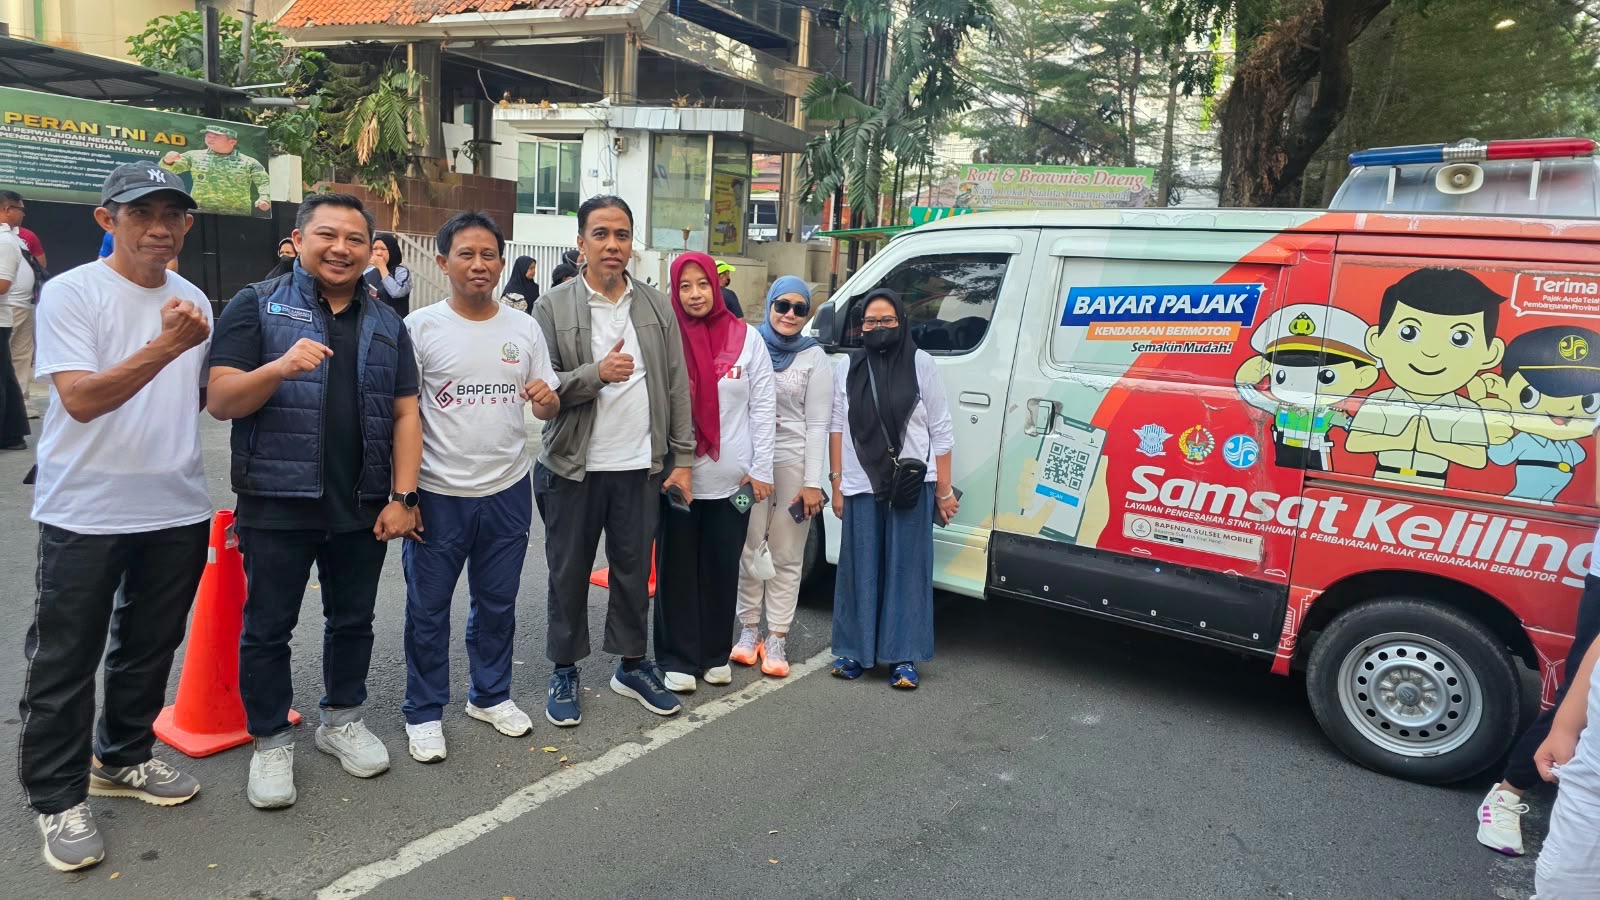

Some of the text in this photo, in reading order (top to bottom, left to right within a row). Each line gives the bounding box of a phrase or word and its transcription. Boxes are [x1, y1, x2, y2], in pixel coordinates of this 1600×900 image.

[4, 111, 187, 147] PERAN TNI AD
[13, 127, 85, 142] PERWUJUDAN
[87, 136, 128, 146] NEGARA
[0, 131, 60, 145] MENGATASI
[62, 139, 122, 152] KEBUTUHAN
[124, 146, 161, 156] RAKYAT
[967, 167, 1146, 192] Roti & Brownies Daeng
[1533, 276, 1598, 295] Terima
[1072, 293, 1249, 315] BAYAR PAJAK
[1523, 301, 1571, 310] Pembangunan
[1543, 294, 1562, 302] Pajak
[1094, 326, 1231, 337] KENDARAAN BERMOTOR
[1130, 342, 1232, 354] Semakin Mudah!
[456, 383, 516, 395] BAPENDA
[456, 395, 516, 405] sulsel
[1049, 491, 1064, 500] SCAN
[1125, 465, 1594, 589] Samsat Keliling
[1154, 521, 1192, 534] BAPENDA
[1194, 528, 1222, 539] SULSEL
[1222, 533, 1254, 544] MOBILE
[1124, 501, 1557, 583] LAYANAN PENGESAHAN STNK TAHUNAN & PEMBAYARAN PAJAK KENDARAAN BERMOTOR
